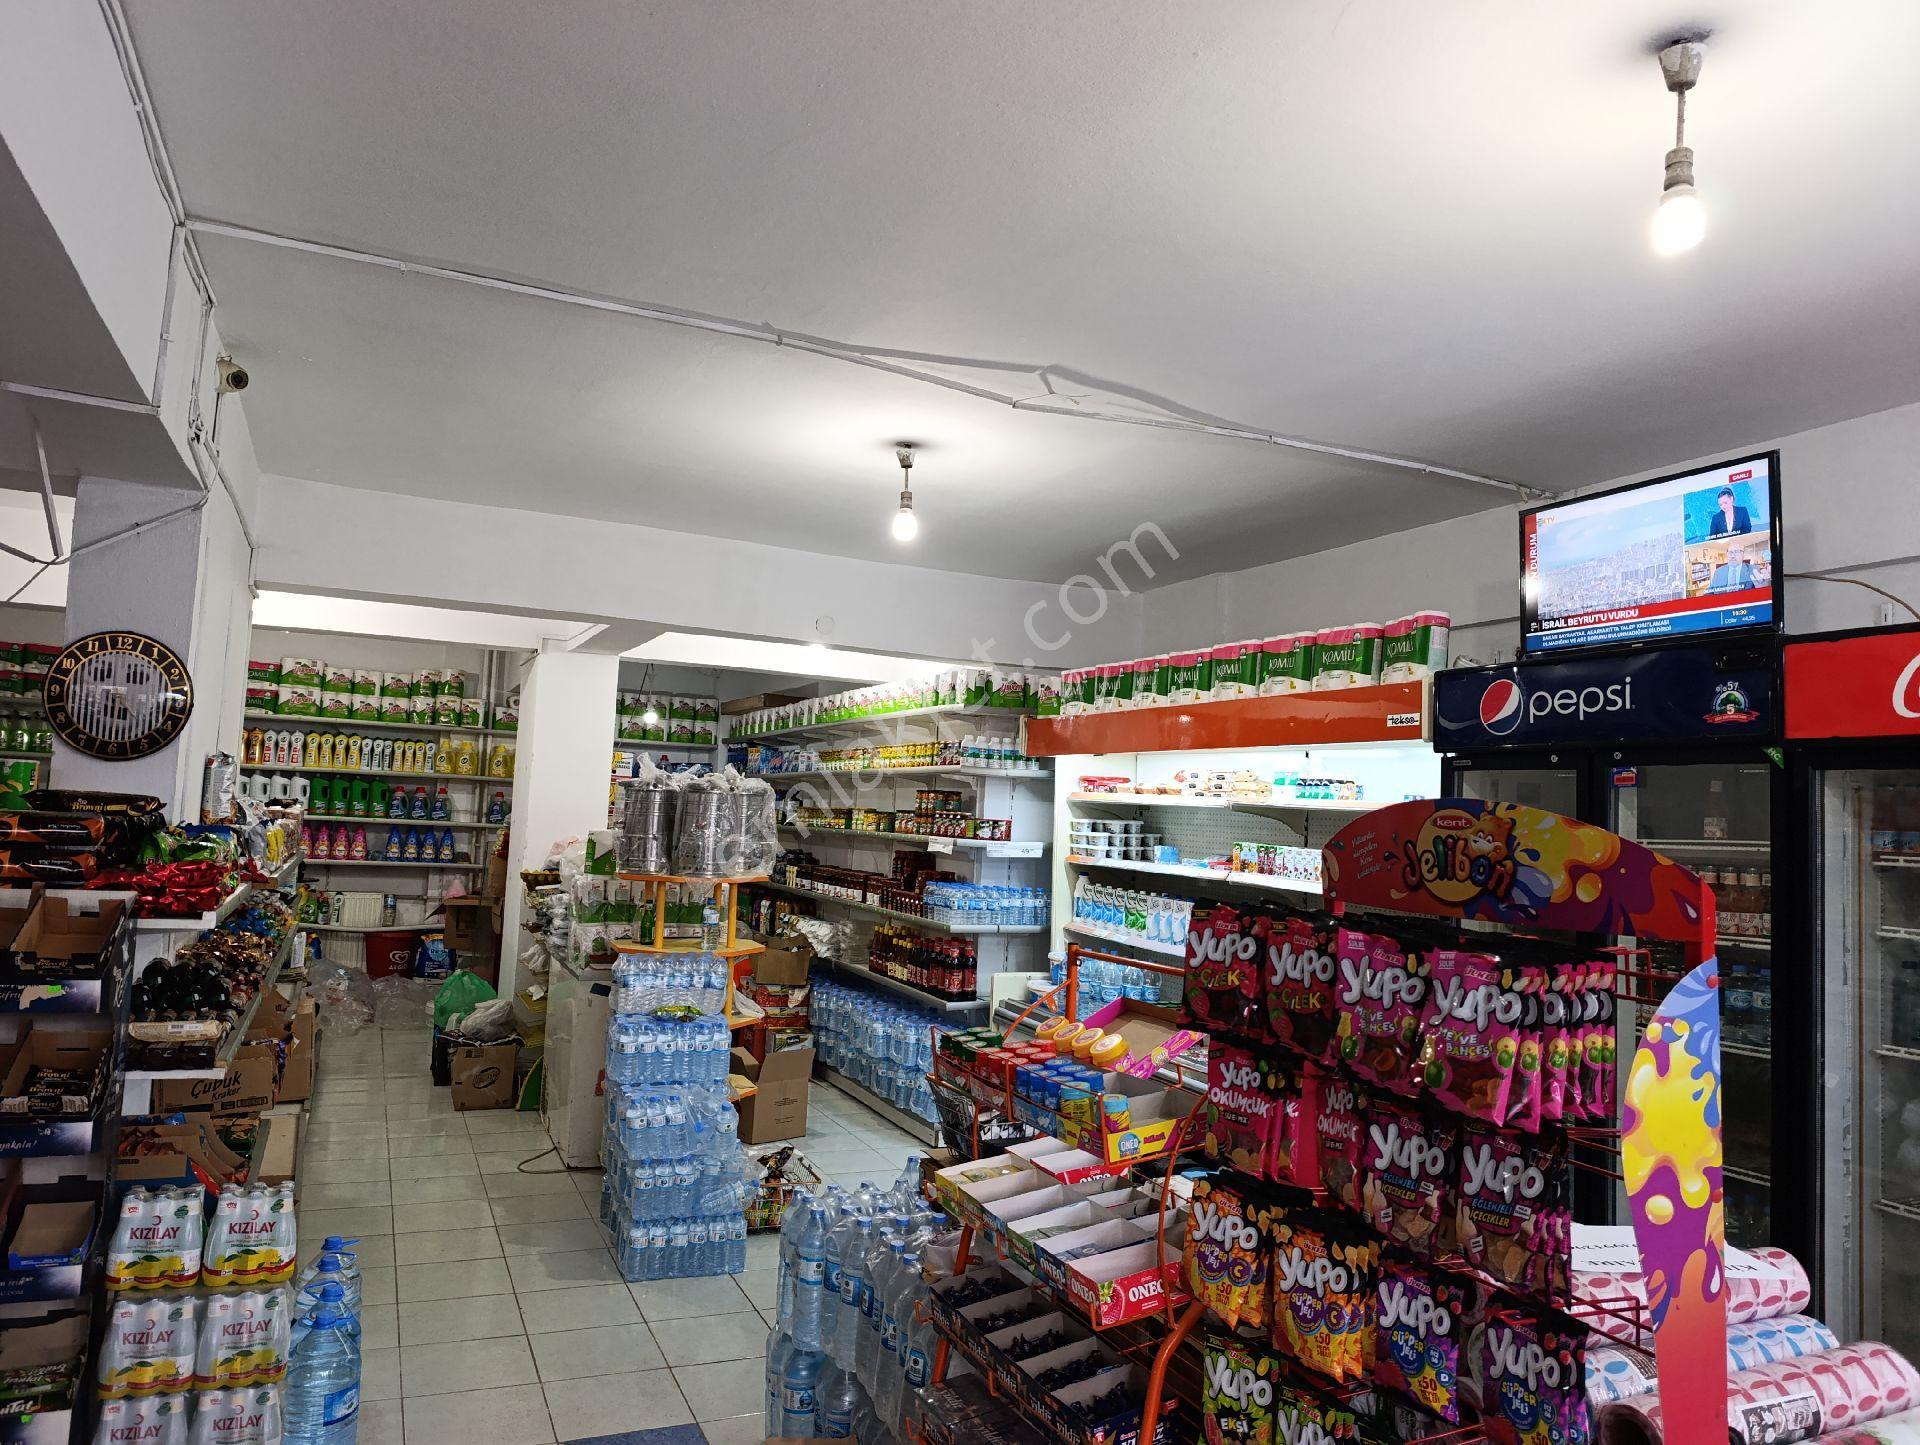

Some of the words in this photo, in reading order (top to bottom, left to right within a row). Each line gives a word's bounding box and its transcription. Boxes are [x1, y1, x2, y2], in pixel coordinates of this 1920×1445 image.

[1732, 473, 1750, 481] CANLI
[1542, 616, 1567, 630] İSRAİL
[1608, 609, 1639, 622] VURDU
[87, 640, 99, 652] 11
[116, 636, 133, 650] 12
[151, 647, 160, 660] 1
[62, 658, 76, 670] 10
[170, 668, 180, 680] 2
[50, 684, 61, 697] 9
[1529, 676, 1631, 724] pepsi
[57, 712, 66, 724] 8
[163, 721, 173, 732] 4
[78, 734, 88, 747] 7
[107, 743, 118, 755] 6
[140, 739, 149, 751] 5
[1403, 834, 1515, 897] Jelibon
[1200, 968, 1241, 988] ÇİLEK
[1281, 988, 1322, 1010] ÇİLEK
[1439, 1026, 1477, 1045] MEYVE
[191, 1070, 242, 1099] Çubuk
[1468, 1208, 1511, 1228] İÇECEKLER
[130, 1226, 181, 1240] KIZILAY
[229, 1221, 277, 1235] KIZILAY
[1200, 1242, 1228, 1263] SÜPPER
[1290, 1291, 1322, 1311] SÜPPER
[222, 1318, 272, 1337] KIZILAY
[122, 1329, 175, 1346] KIZILAY
[1391, 1330, 1425, 1354] SÜPPER
[1400, 1344, 1417, 1361] JELİ
[1440, 1374, 1449, 1382] D
[1500, 1380, 1537, 1407] SÜPPER
[1510, 1397, 1529, 1416] JELİ
[213, 1413, 264, 1431] KIZILAY
[110, 1424, 164, 1442] KIZILAY
[1552, 1430, 1560, 1440] D
